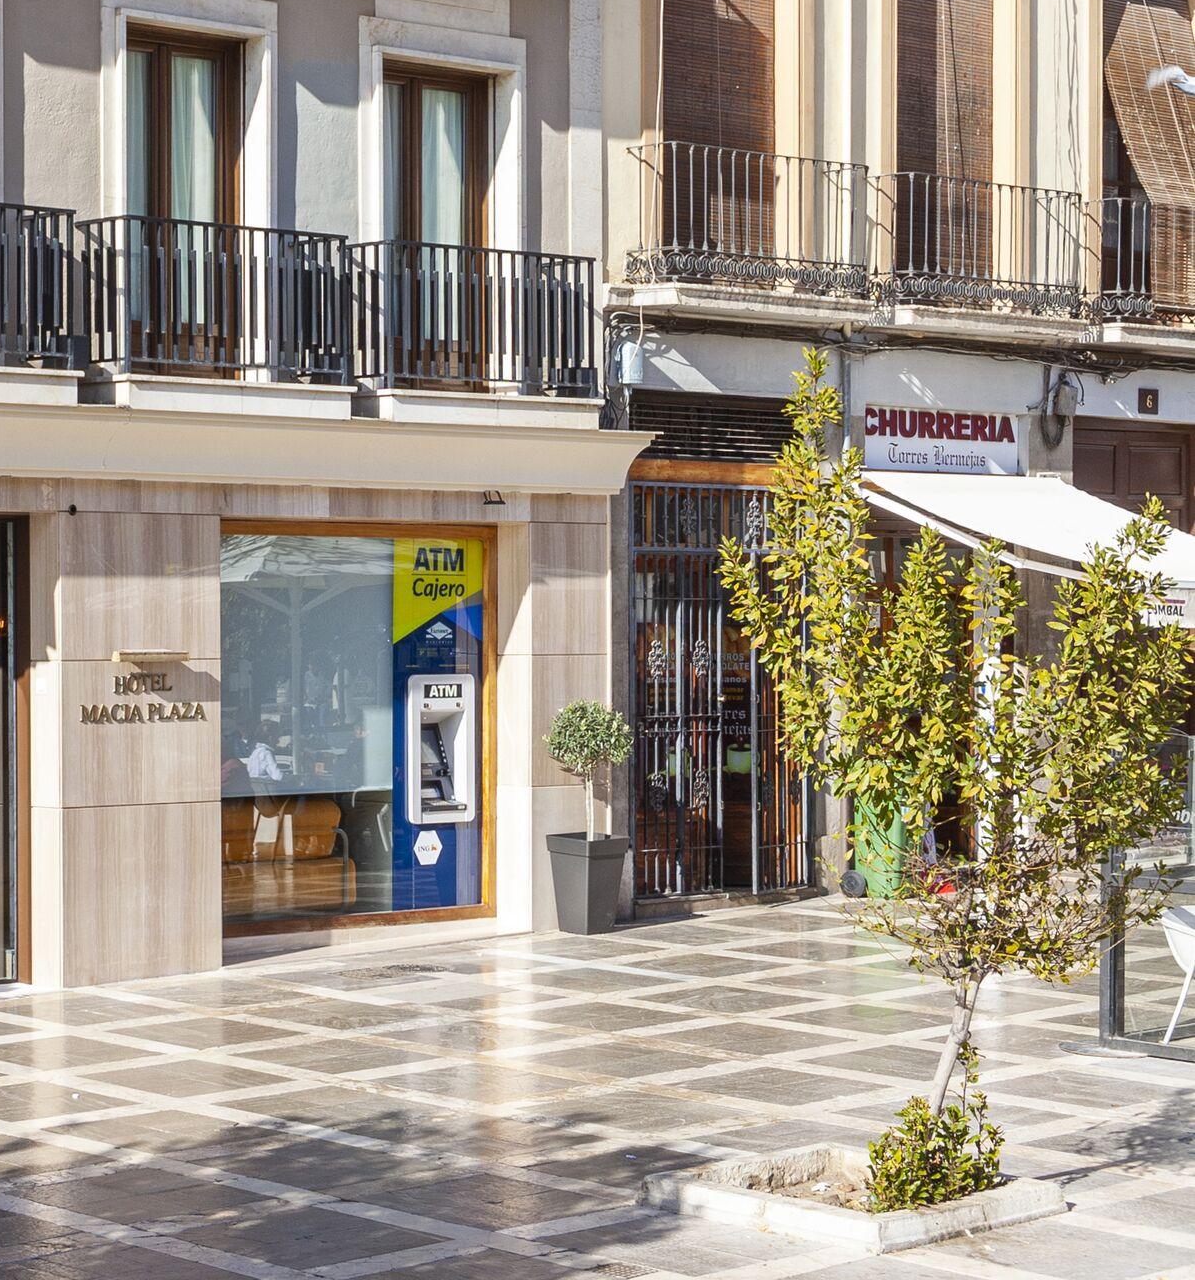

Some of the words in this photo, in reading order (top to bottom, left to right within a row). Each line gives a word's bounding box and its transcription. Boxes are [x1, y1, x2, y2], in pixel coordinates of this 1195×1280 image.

[1146, 394, 1153, 409] 6
[865, 407, 1016, 443] CHURRERIA
[888, 442, 928, 465] Torres
[933, 445, 986, 469] Bermejas
[413, 547, 464, 571] ATM
[412, 578, 465, 601] Cajero
[112, 671, 173, 695] HOTEL
[429, 684, 458, 698] ATM
[79, 703, 145, 724] MACIA
[146, 701, 207, 722] PLAZA
